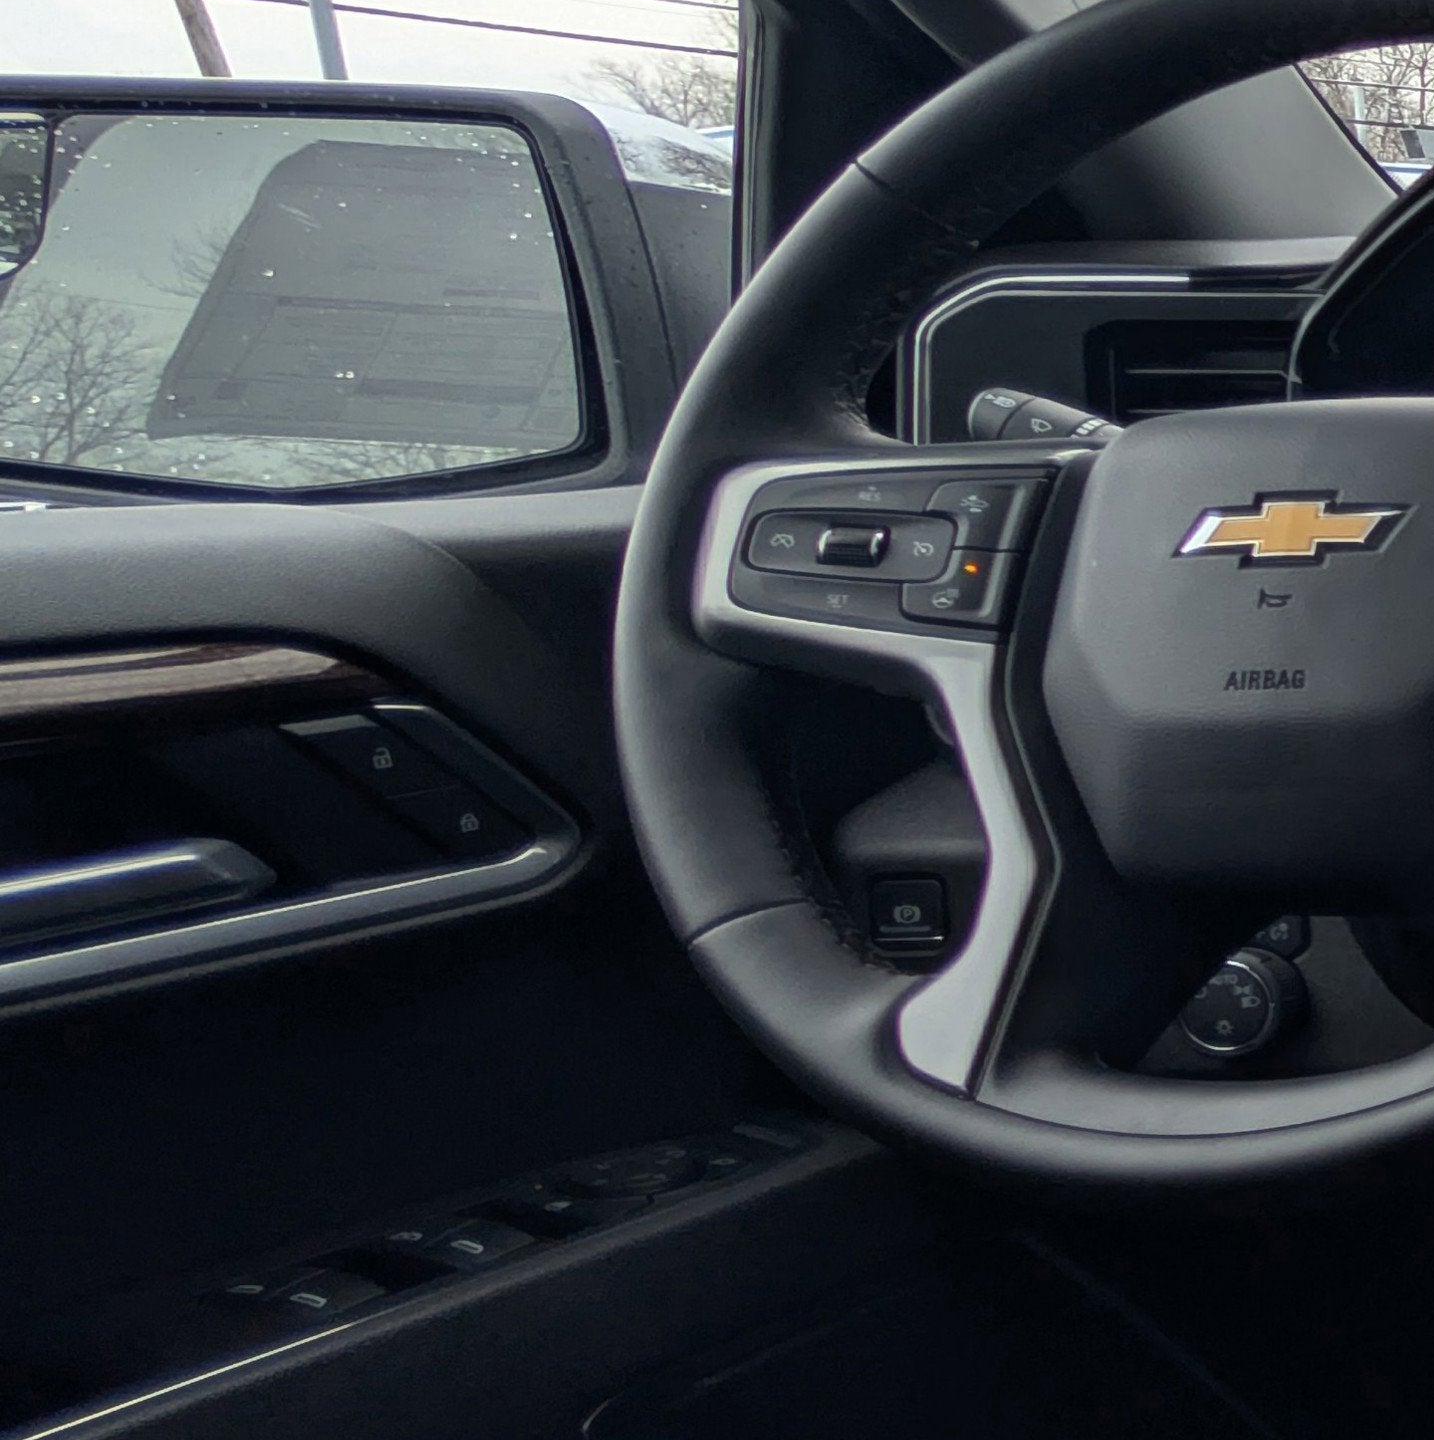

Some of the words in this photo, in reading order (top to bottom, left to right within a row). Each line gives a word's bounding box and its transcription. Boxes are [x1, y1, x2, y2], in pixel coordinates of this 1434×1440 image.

[858, 491, 882, 502] RES
[826, 593, 850, 605] SET
[1223, 668, 1306, 691] AIRBAG
